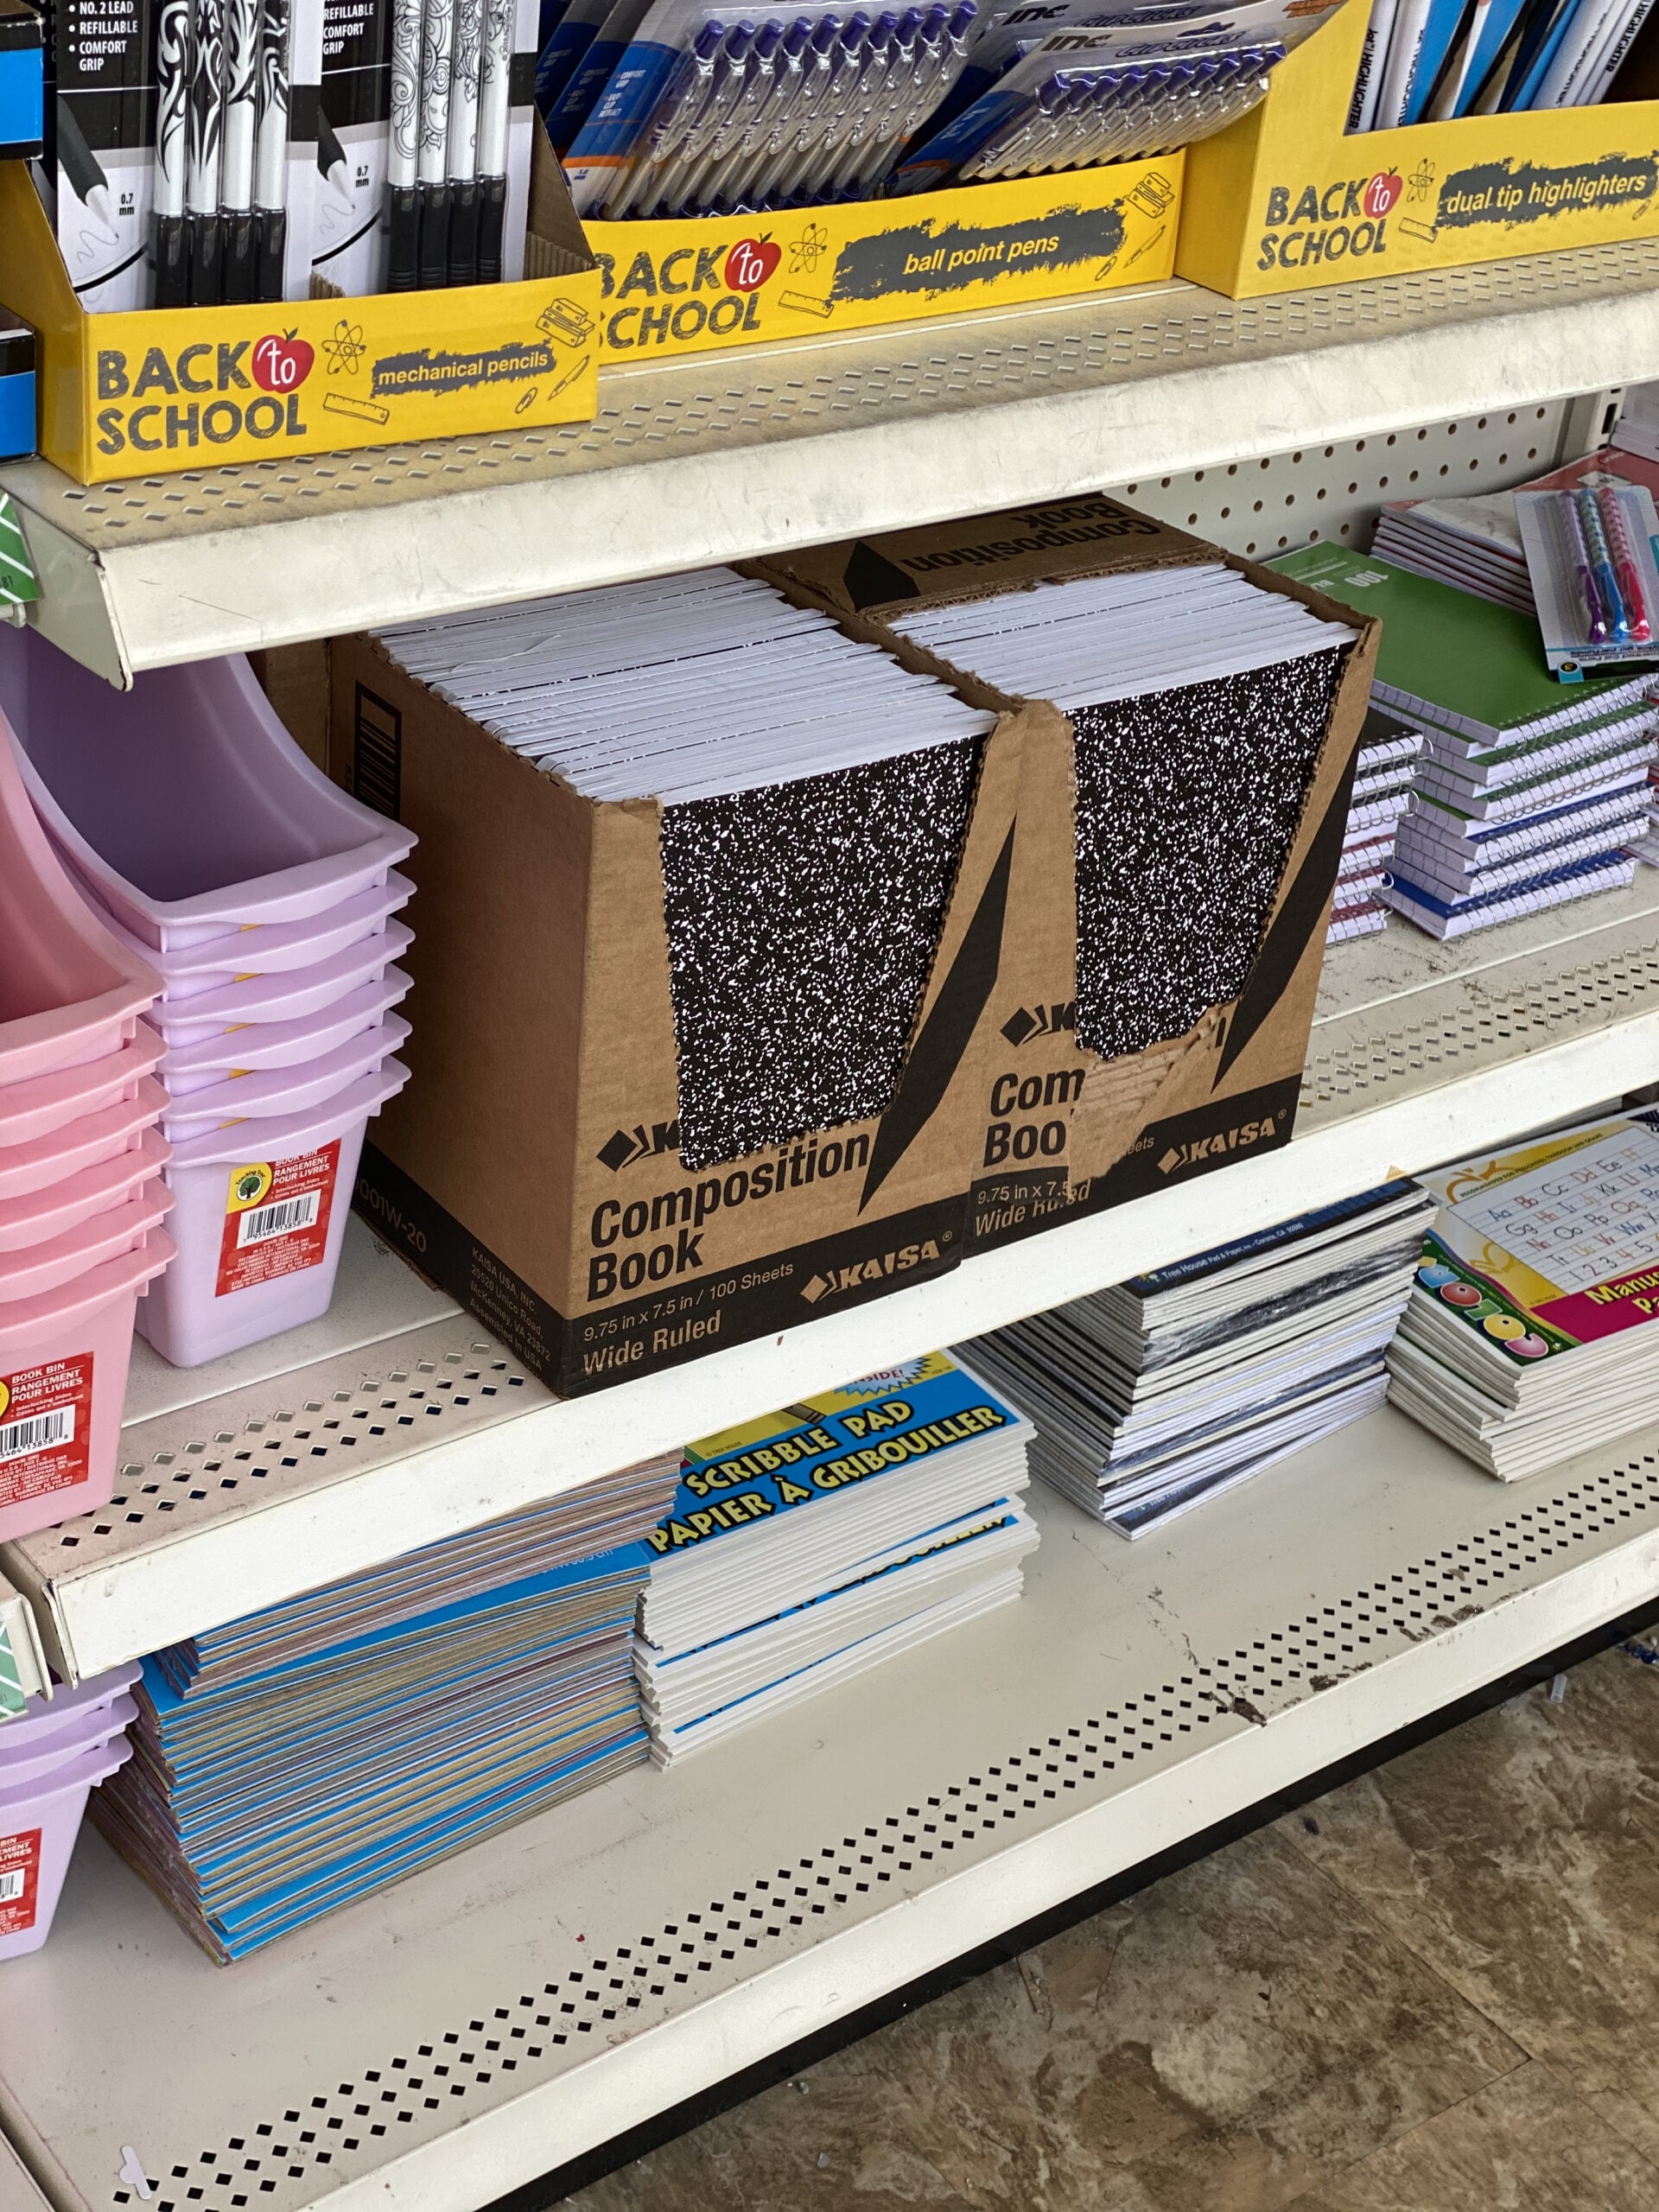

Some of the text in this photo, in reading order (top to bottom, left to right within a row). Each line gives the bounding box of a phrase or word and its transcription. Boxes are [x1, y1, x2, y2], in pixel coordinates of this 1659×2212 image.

[79, 1, 135, 15] NO. 2 LEAD
[323, 3, 374, 21] REFILLABLE
[79, 20, 138, 35] REFILLABLE
[323, 22, 365, 40] COMFORT
[79, 41, 128, 54] COMFORT
[79, 57, 105, 71] GRIP
[323, 41, 345, 55] GRIP
[1348, 49, 1374, 129] HIGHLIGHTER
[355, 177, 370, 188] mm
[357, 165, 369, 176] 0.7
[120, 194, 133, 204] 0.7
[1265, 175, 1391, 226] BACK to
[1446, 174, 1647, 214] dual tip highlighters
[119, 206, 135, 216] mm
[902, 236, 1059, 275] ball point pens
[1257, 219, 1387, 271] SCHOOL
[594, 243, 764, 299] BACK to
[600, 292, 760, 349] CHOOL
[98, 339, 296, 400] BACK to
[378, 351, 548, 385] mechanical pencils
[96, 393, 308, 455] SCHOOL
[1010, 502, 1129, 529] Book
[899, 519, 1161, 572] Composition
[1344, 570, 1389, 588] 100
[983, 1120, 1067, 1168] Boo
[1127, 1136, 1154, 1155] eets
[1191, 1116, 1276, 1163] KAISA
[272, 1164, 330, 1186] POUR LIVRES
[274, 1155, 329, 1178] RANGEMENT
[591, 1134, 871, 1249] Composition
[977, 1185, 1010, 1205] 9.75
[1014, 1184, 1028, 1199] in
[1032, 1185, 1041, 1197] x
[976, 1203, 1027, 1236] Wide
[473, 1247, 498, 1276] KAISA
[587, 1229, 705, 1302] Book
[838, 1239, 941, 1289] KAISA
[1582, 1263, 1602, 1276] 2
[1599, 1256, 1618, 1269] 3
[472, 1264, 543, 1339] 20520 Unico Road,
[583, 1262, 794, 1342] 9.75 in x 7.5 in / 100 Sheets
[470, 1280, 551, 1363] McKenney, VA 23872
[470, 1298, 514, 1342] Assembled
[524, 1347, 543, 1371] USA
[583, 1309, 721, 1376] Wide Ruled
[11, 1363, 66, 1384] BOOK BIN
[11, 1369, 81, 1395] RANGEMENT
[11, 1376, 84, 1404] POUR LIVRES
[16, 1392, 72, 1412] Interlocking Sides
[842, 1400, 912, 1440] PAD
[648, 1491, 775, 1554] PAPIER
[772, 1472, 812, 1504] À
[810, 1403, 1007, 1490] GRIBOUILLER
[683, 1426, 842, 1498] SCRIBBLE
[0, 1837, 17, 1847] BIN
